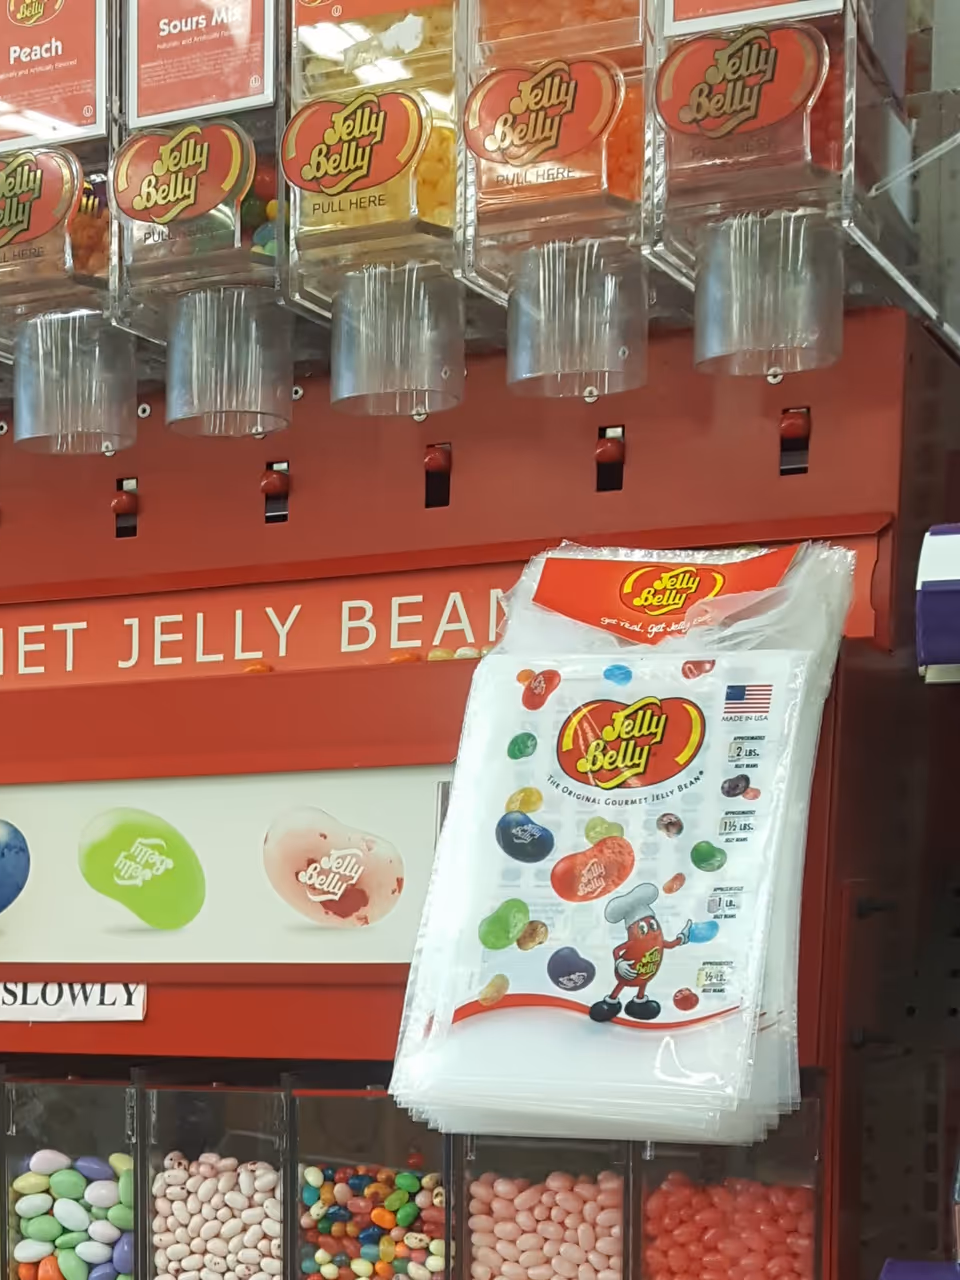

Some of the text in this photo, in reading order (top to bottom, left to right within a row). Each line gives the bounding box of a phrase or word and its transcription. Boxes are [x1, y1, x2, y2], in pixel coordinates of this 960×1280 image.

[159, 14, 207, 37] Sours
[9, 37, 63, 65] Peach
[706, 28, 778, 86] Jelly
[510, 60, 577, 115] Jelly
[679, 83, 761, 138] Belly
[325, 94, 385, 148] Jelly
[484, 112, 561, 165] Belly
[153, 126, 209, 175] Jelly
[302, 144, 373, 196] Belly
[535, 166, 577, 182] HERE
[133, 172, 198, 224] Belly
[312, 194, 387, 215] PULL HERE
[118, 604, 302, 669] JELLY
[602, 698, 668, 743] Jelly
[577, 741, 652, 789] Belly
[744, 748, 760, 757] LBS.
[547, 774, 561, 789] THE
[561, 785, 601, 805] ORIGINAL
[651, 788, 675, 802] JELLY
[1, 982, 141, 1007] SLOWLY
